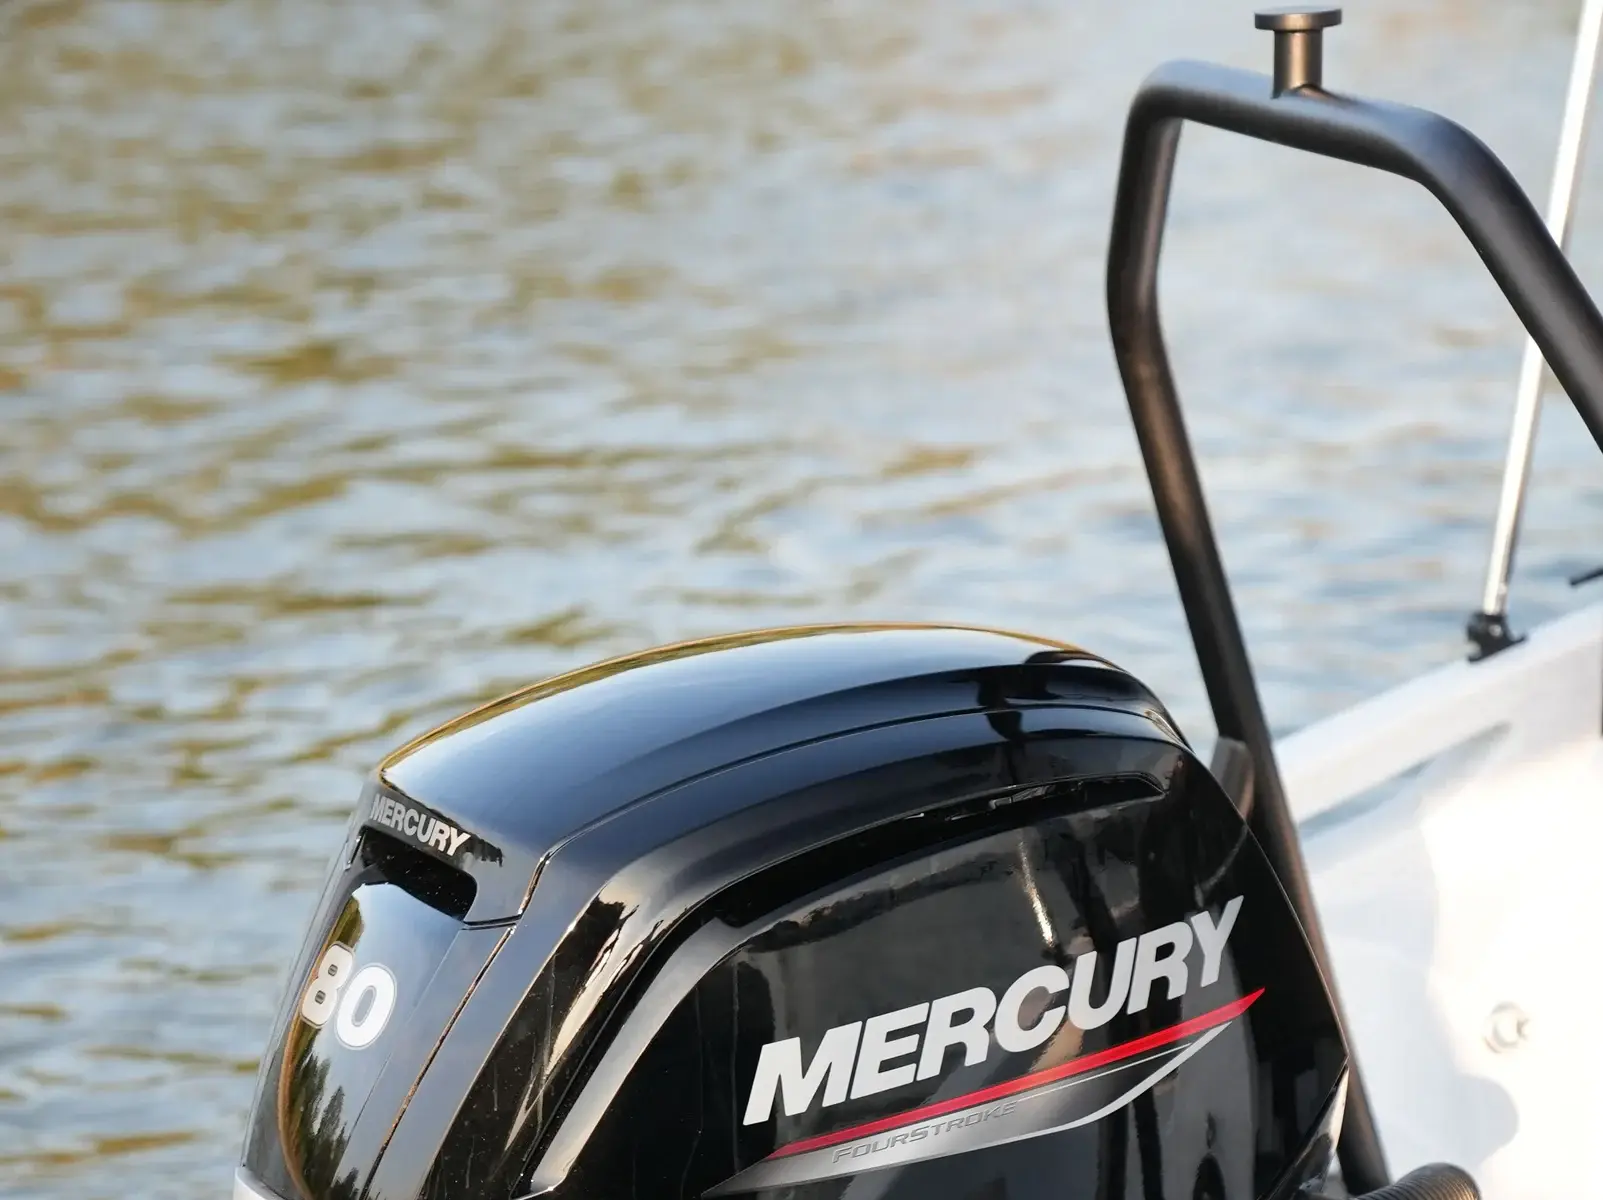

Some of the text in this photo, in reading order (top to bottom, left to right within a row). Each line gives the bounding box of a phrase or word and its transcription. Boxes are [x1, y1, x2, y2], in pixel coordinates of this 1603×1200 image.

[370, 794, 471, 856] MERCURY
[301, 941, 397, 1050] 80
[743, 896, 1244, 1126] MERCURY
[832, 1102, 1016, 1162] FOURSTROKE
